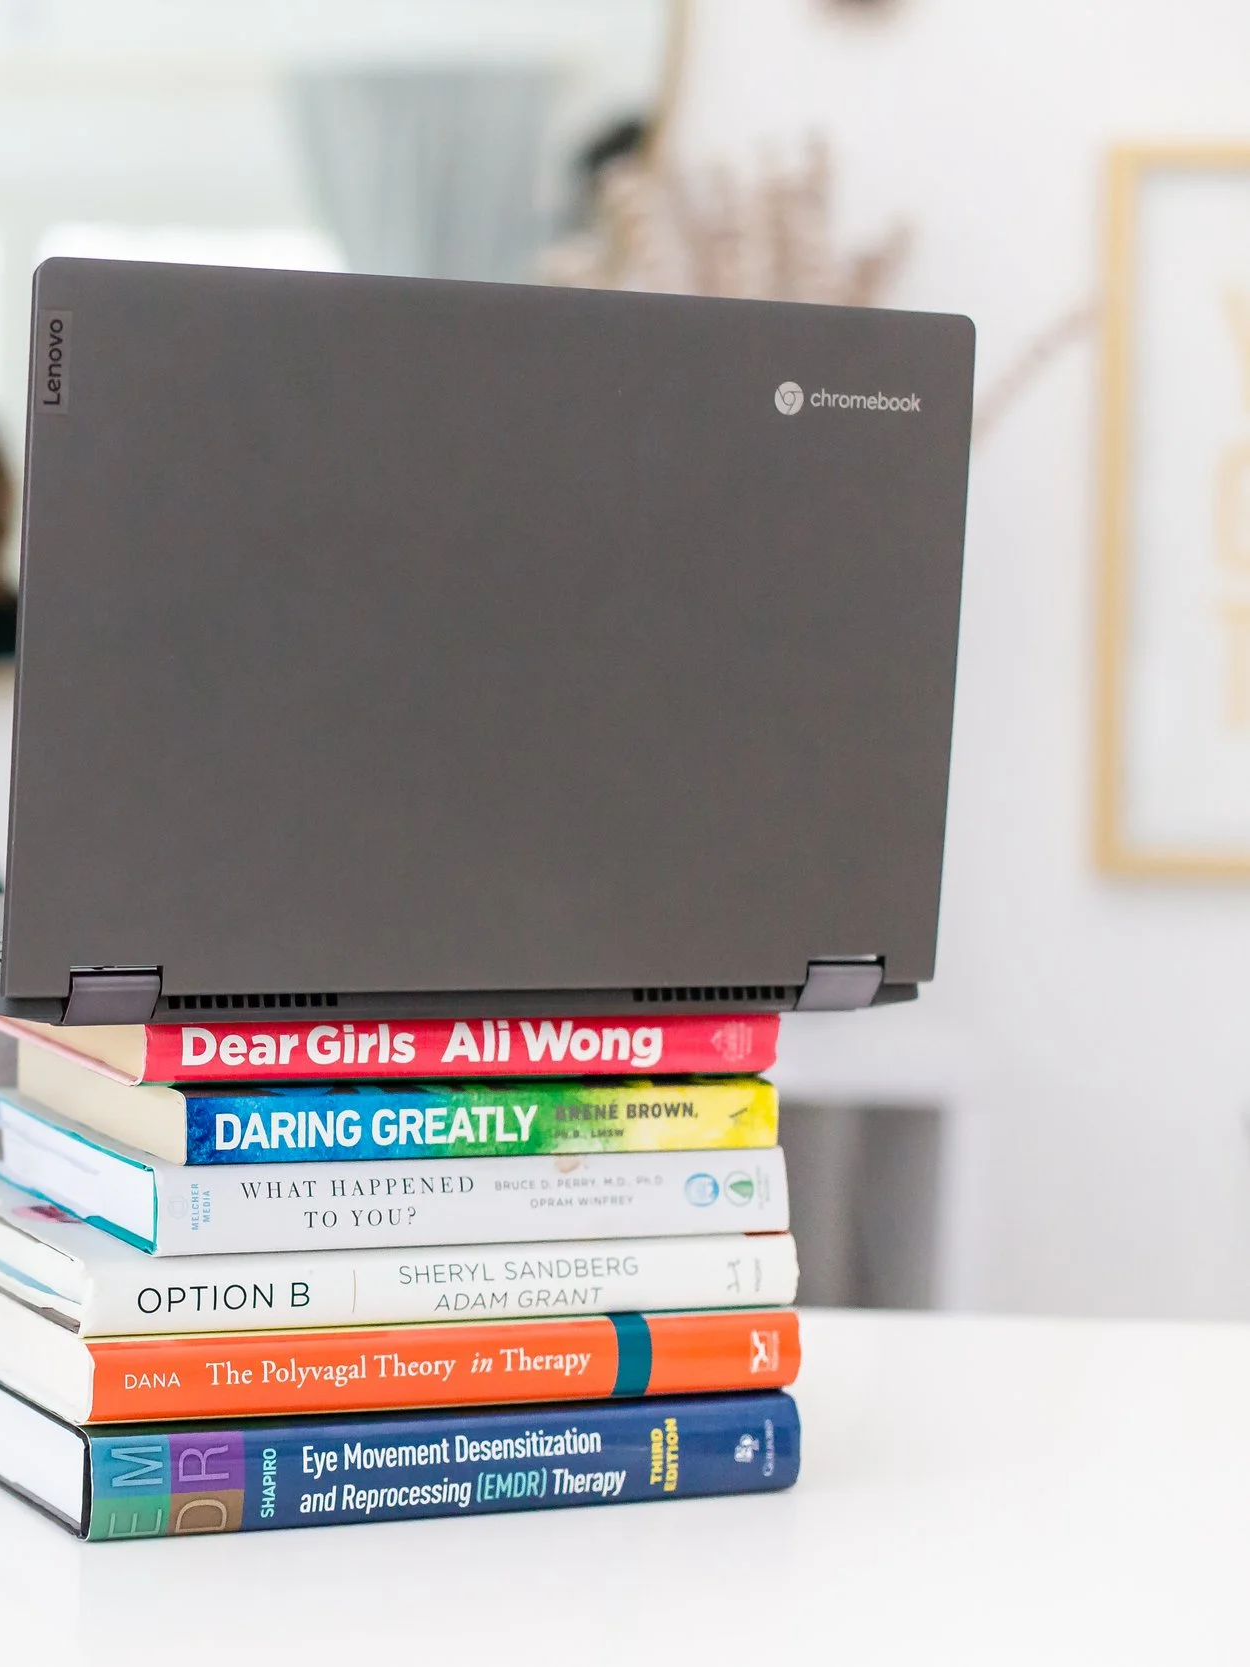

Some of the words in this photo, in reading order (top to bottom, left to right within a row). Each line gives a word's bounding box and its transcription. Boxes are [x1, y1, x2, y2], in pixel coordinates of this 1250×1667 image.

[43, 318, 64, 407] Lenovo
[810, 388, 921, 413] chromebook
[181, 1026, 299, 1066] Dear
[306, 1024, 416, 1065] Girls
[441, 1020, 510, 1063] Ali
[519, 1020, 664, 1067] Wong
[215, 1110, 362, 1150] DARING
[371, 1105, 538, 1146] GREATLY
[241, 1180, 317, 1200] WHAT
[331, 1175, 474, 1197] HAPPENED
[494, 1179, 536, 1191] BRUCE
[530, 1198, 574, 1209] OPRAH
[578, 1195, 634, 1207] WINFREY
[190, 1183, 200, 1231] MELCHER
[202, 1190, 211, 1223] MEDIA
[303, 1210, 338, 1229] TO
[351, 1206, 417, 1227] YOU?
[399, 1263, 495, 1285] SHERYL
[504, 1256, 639, 1281] SANDBERG
[137, 1283, 273, 1314] OPTION
[290, 1281, 311, 1308] B
[434, 1291, 509, 1312] ADAM
[517, 1286, 603, 1309] GRANT
[124, 1372, 181, 1390] DANA
[205, 1360, 253, 1386] The
[261, 1354, 367, 1389] Polyvagal
[373, 1352, 456, 1382] Theory
[470, 1352, 494, 1374] in
[500, 1347, 591, 1377] Therapy
[302, 1445, 338, 1480] Eye
[344, 1438, 450, 1471] Movement
[455, 1427, 602, 1463] Desensitization
[650, 1428, 664, 1485] THIRD
[663, 1417, 679, 1492] EDITION
[261, 1448, 276, 1519] SHAPIRO
[300, 1485, 337, 1513] and
[341, 1477, 472, 1514] Reprocessing
[476, 1466, 547, 1501] (EMDR)
[552, 1467, 627, 1497] Therapy
